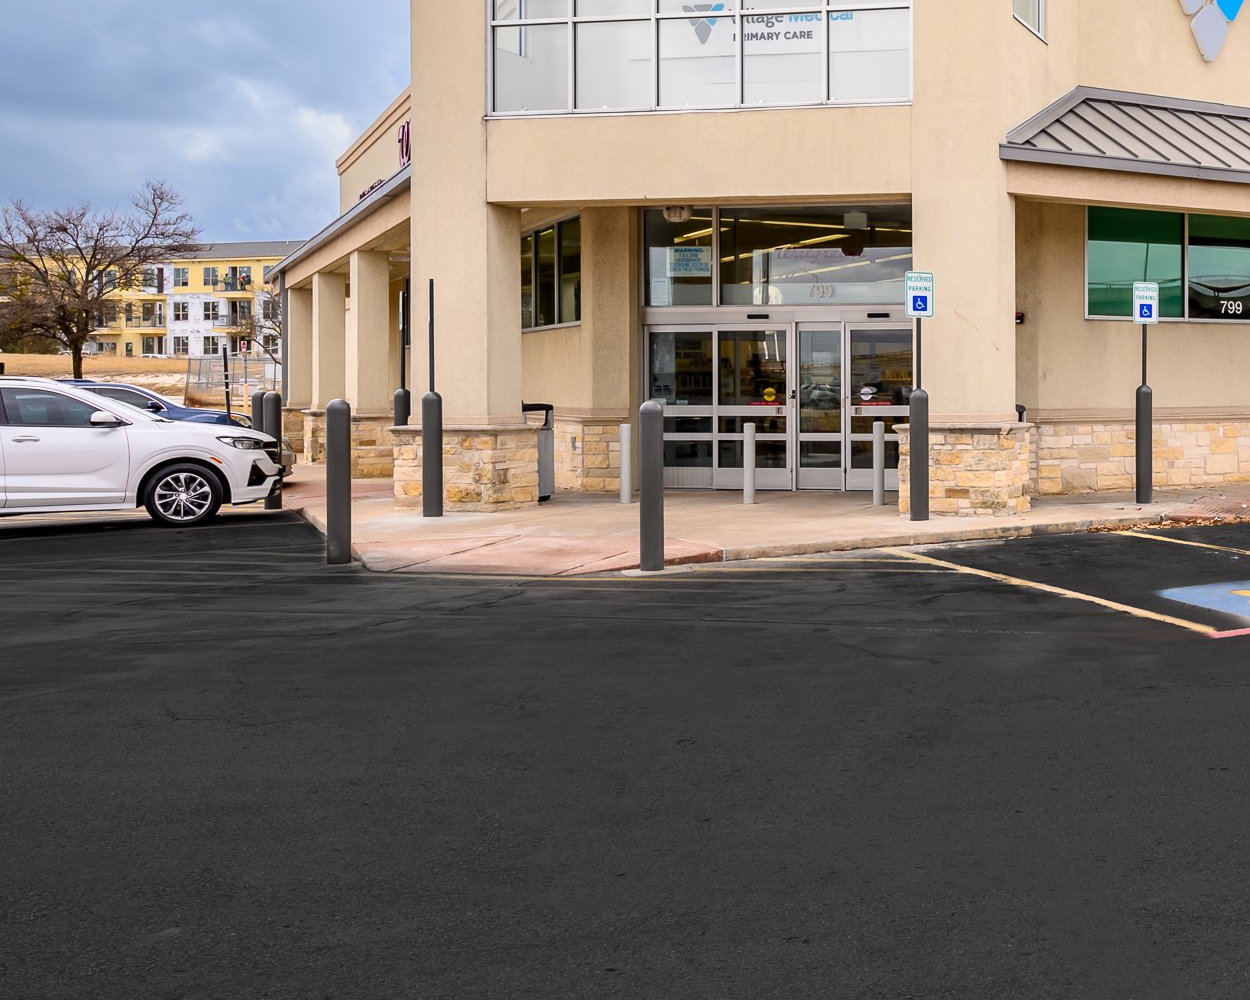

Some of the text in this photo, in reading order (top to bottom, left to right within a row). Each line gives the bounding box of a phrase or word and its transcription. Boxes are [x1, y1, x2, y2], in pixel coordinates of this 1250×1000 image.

[784, 30, 813, 40] CARE
[808, 284, 834, 298] 799
[1220, 301, 1243, 314] 799
